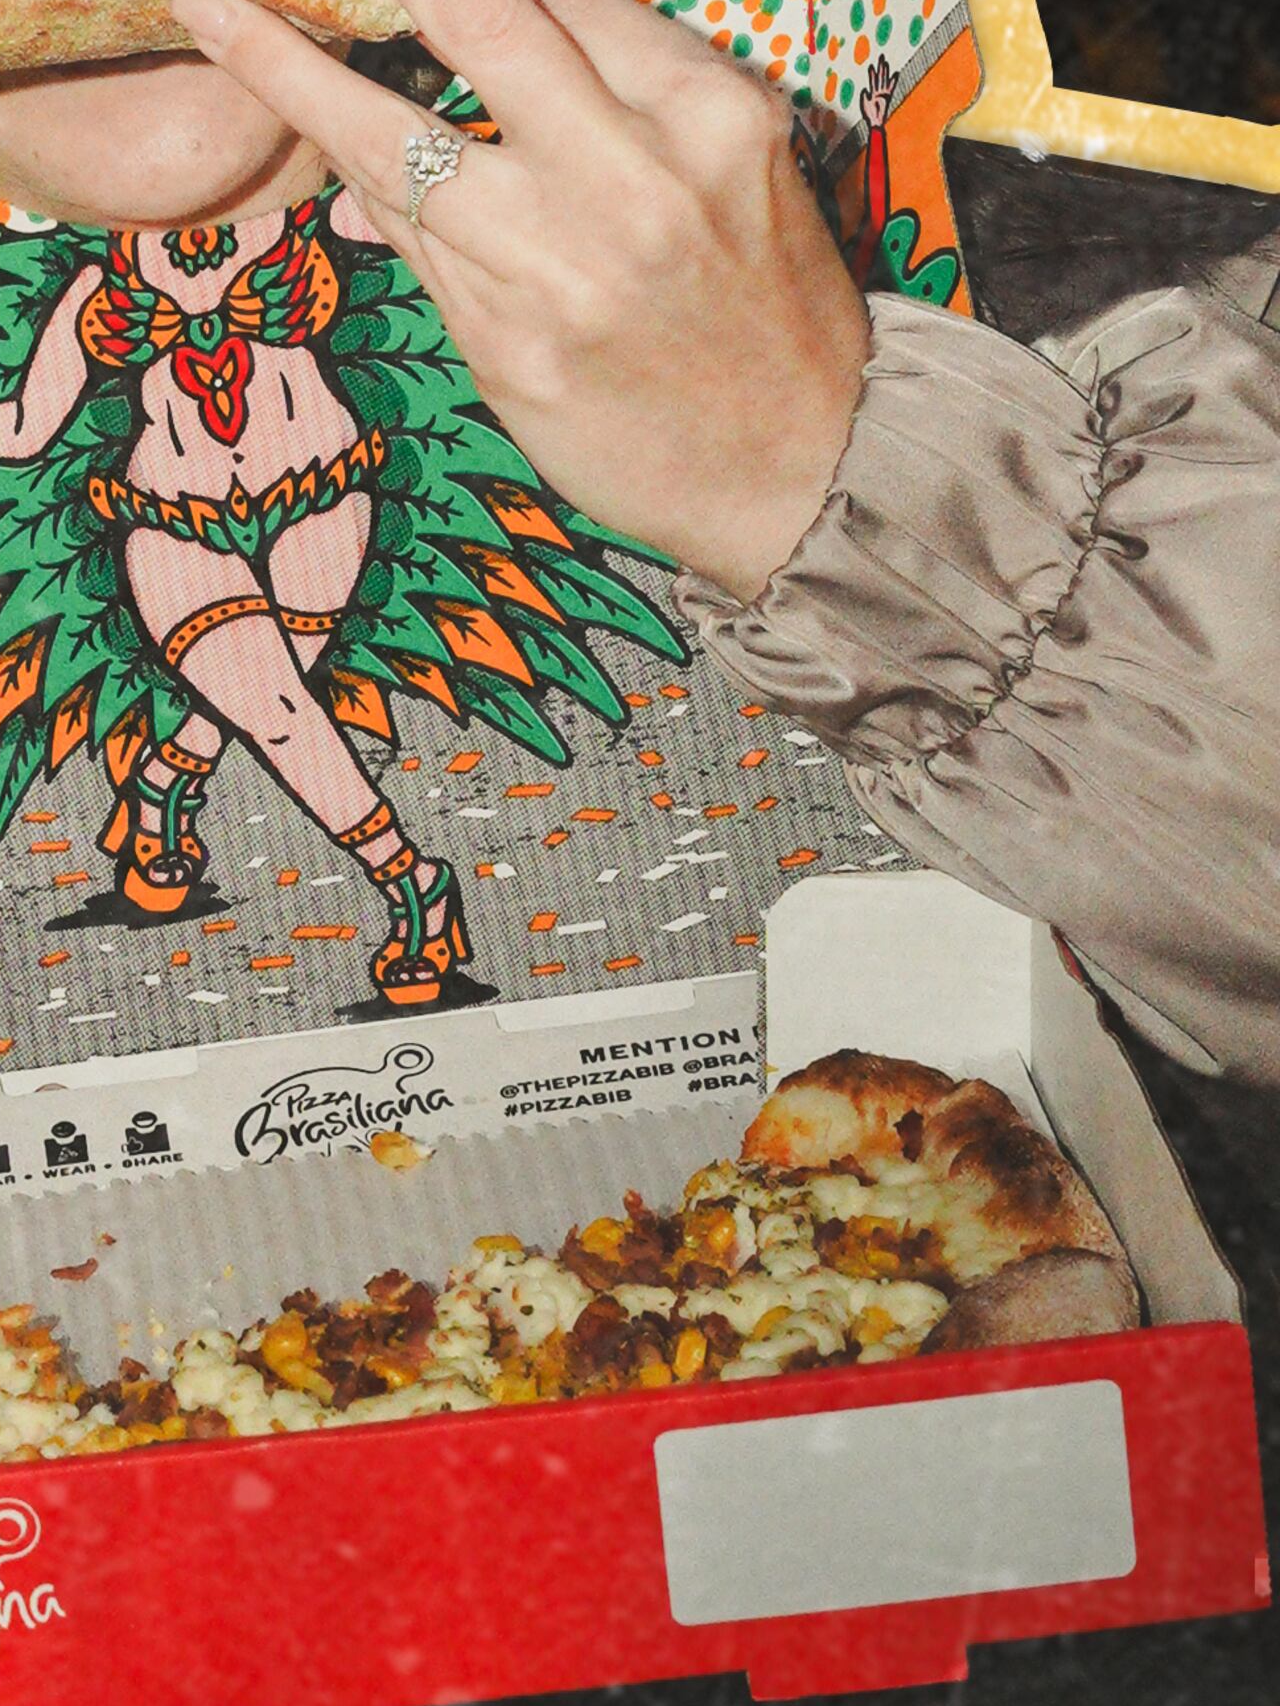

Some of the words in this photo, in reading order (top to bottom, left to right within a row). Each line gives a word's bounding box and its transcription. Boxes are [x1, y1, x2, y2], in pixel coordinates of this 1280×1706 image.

[579, 1028, 741, 1065] MENTION
[500, 1062, 675, 1099] @THEPIZZABIB
[682, 1051, 760, 1074] @BRA
[503, 1089, 633, 1117] #PIZZABIB
[687, 1072, 758, 1093] #BRA
[234, 1089, 455, 1165] Brasiliana
[42, 1164, 97, 1179] WEAR
